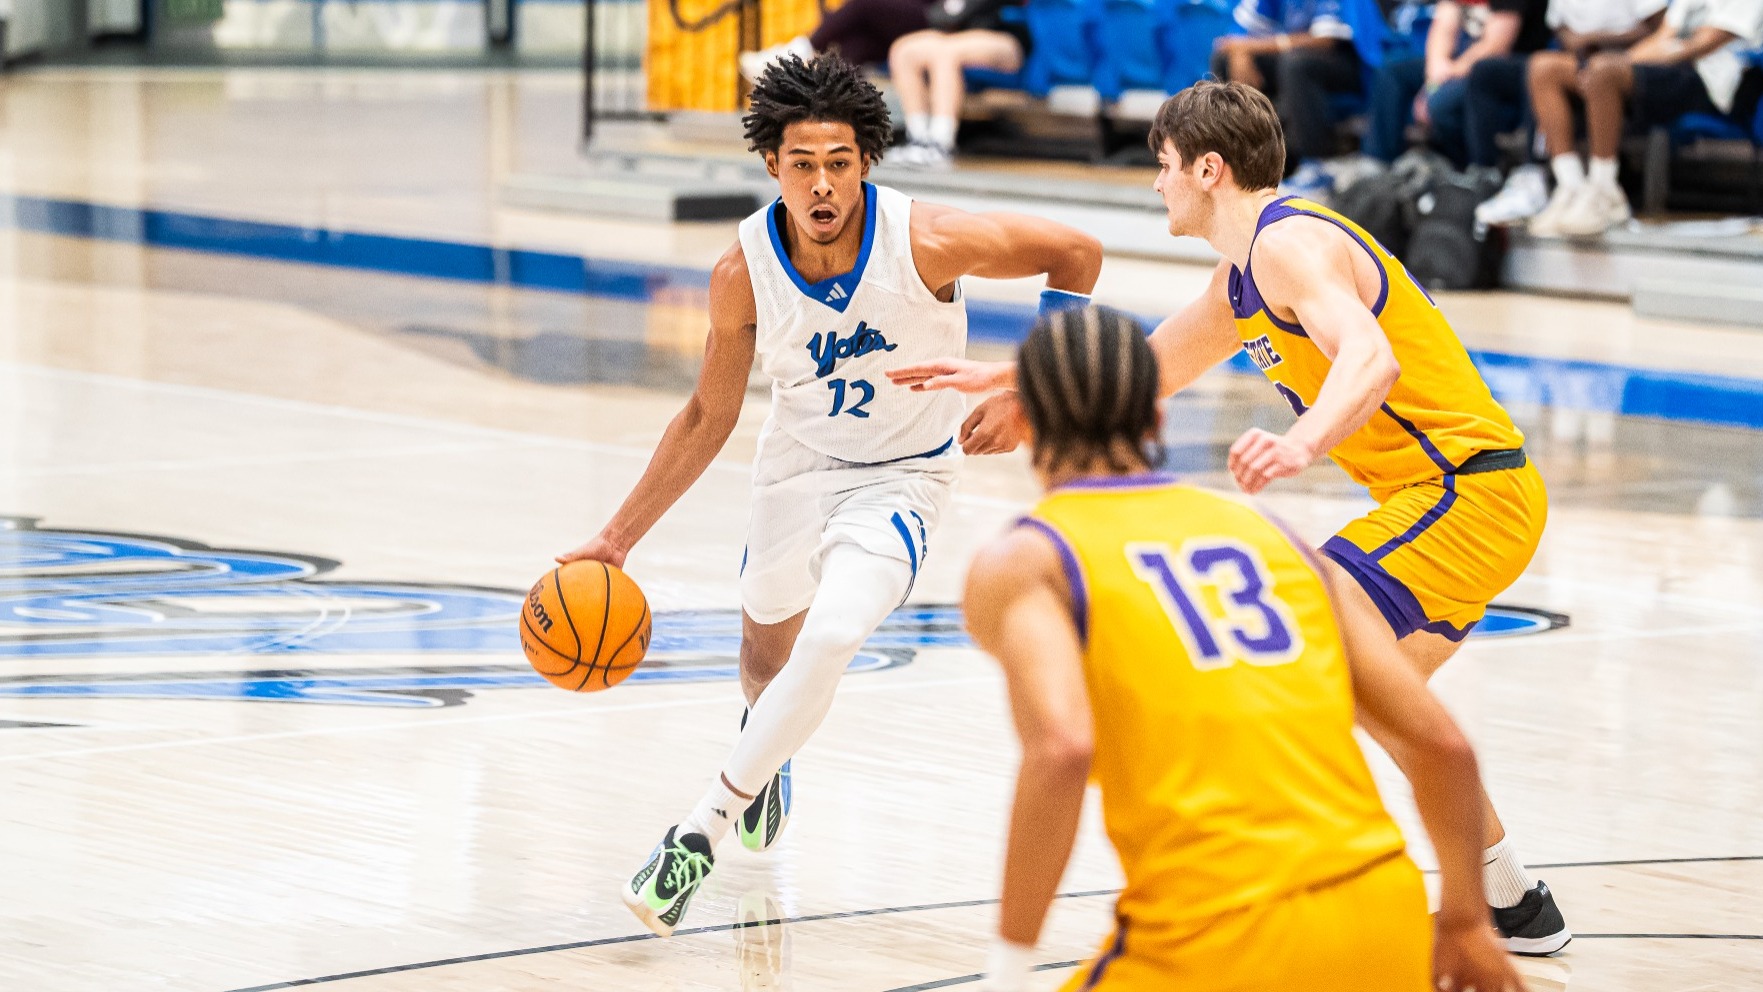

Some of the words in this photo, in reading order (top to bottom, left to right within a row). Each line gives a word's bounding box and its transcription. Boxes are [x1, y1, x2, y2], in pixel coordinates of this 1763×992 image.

[806, 320, 898, 379] Yotes
[827, 378, 875, 418] 12
[529, 582, 553, 634] lson
[1132, 542, 1298, 664] 13
